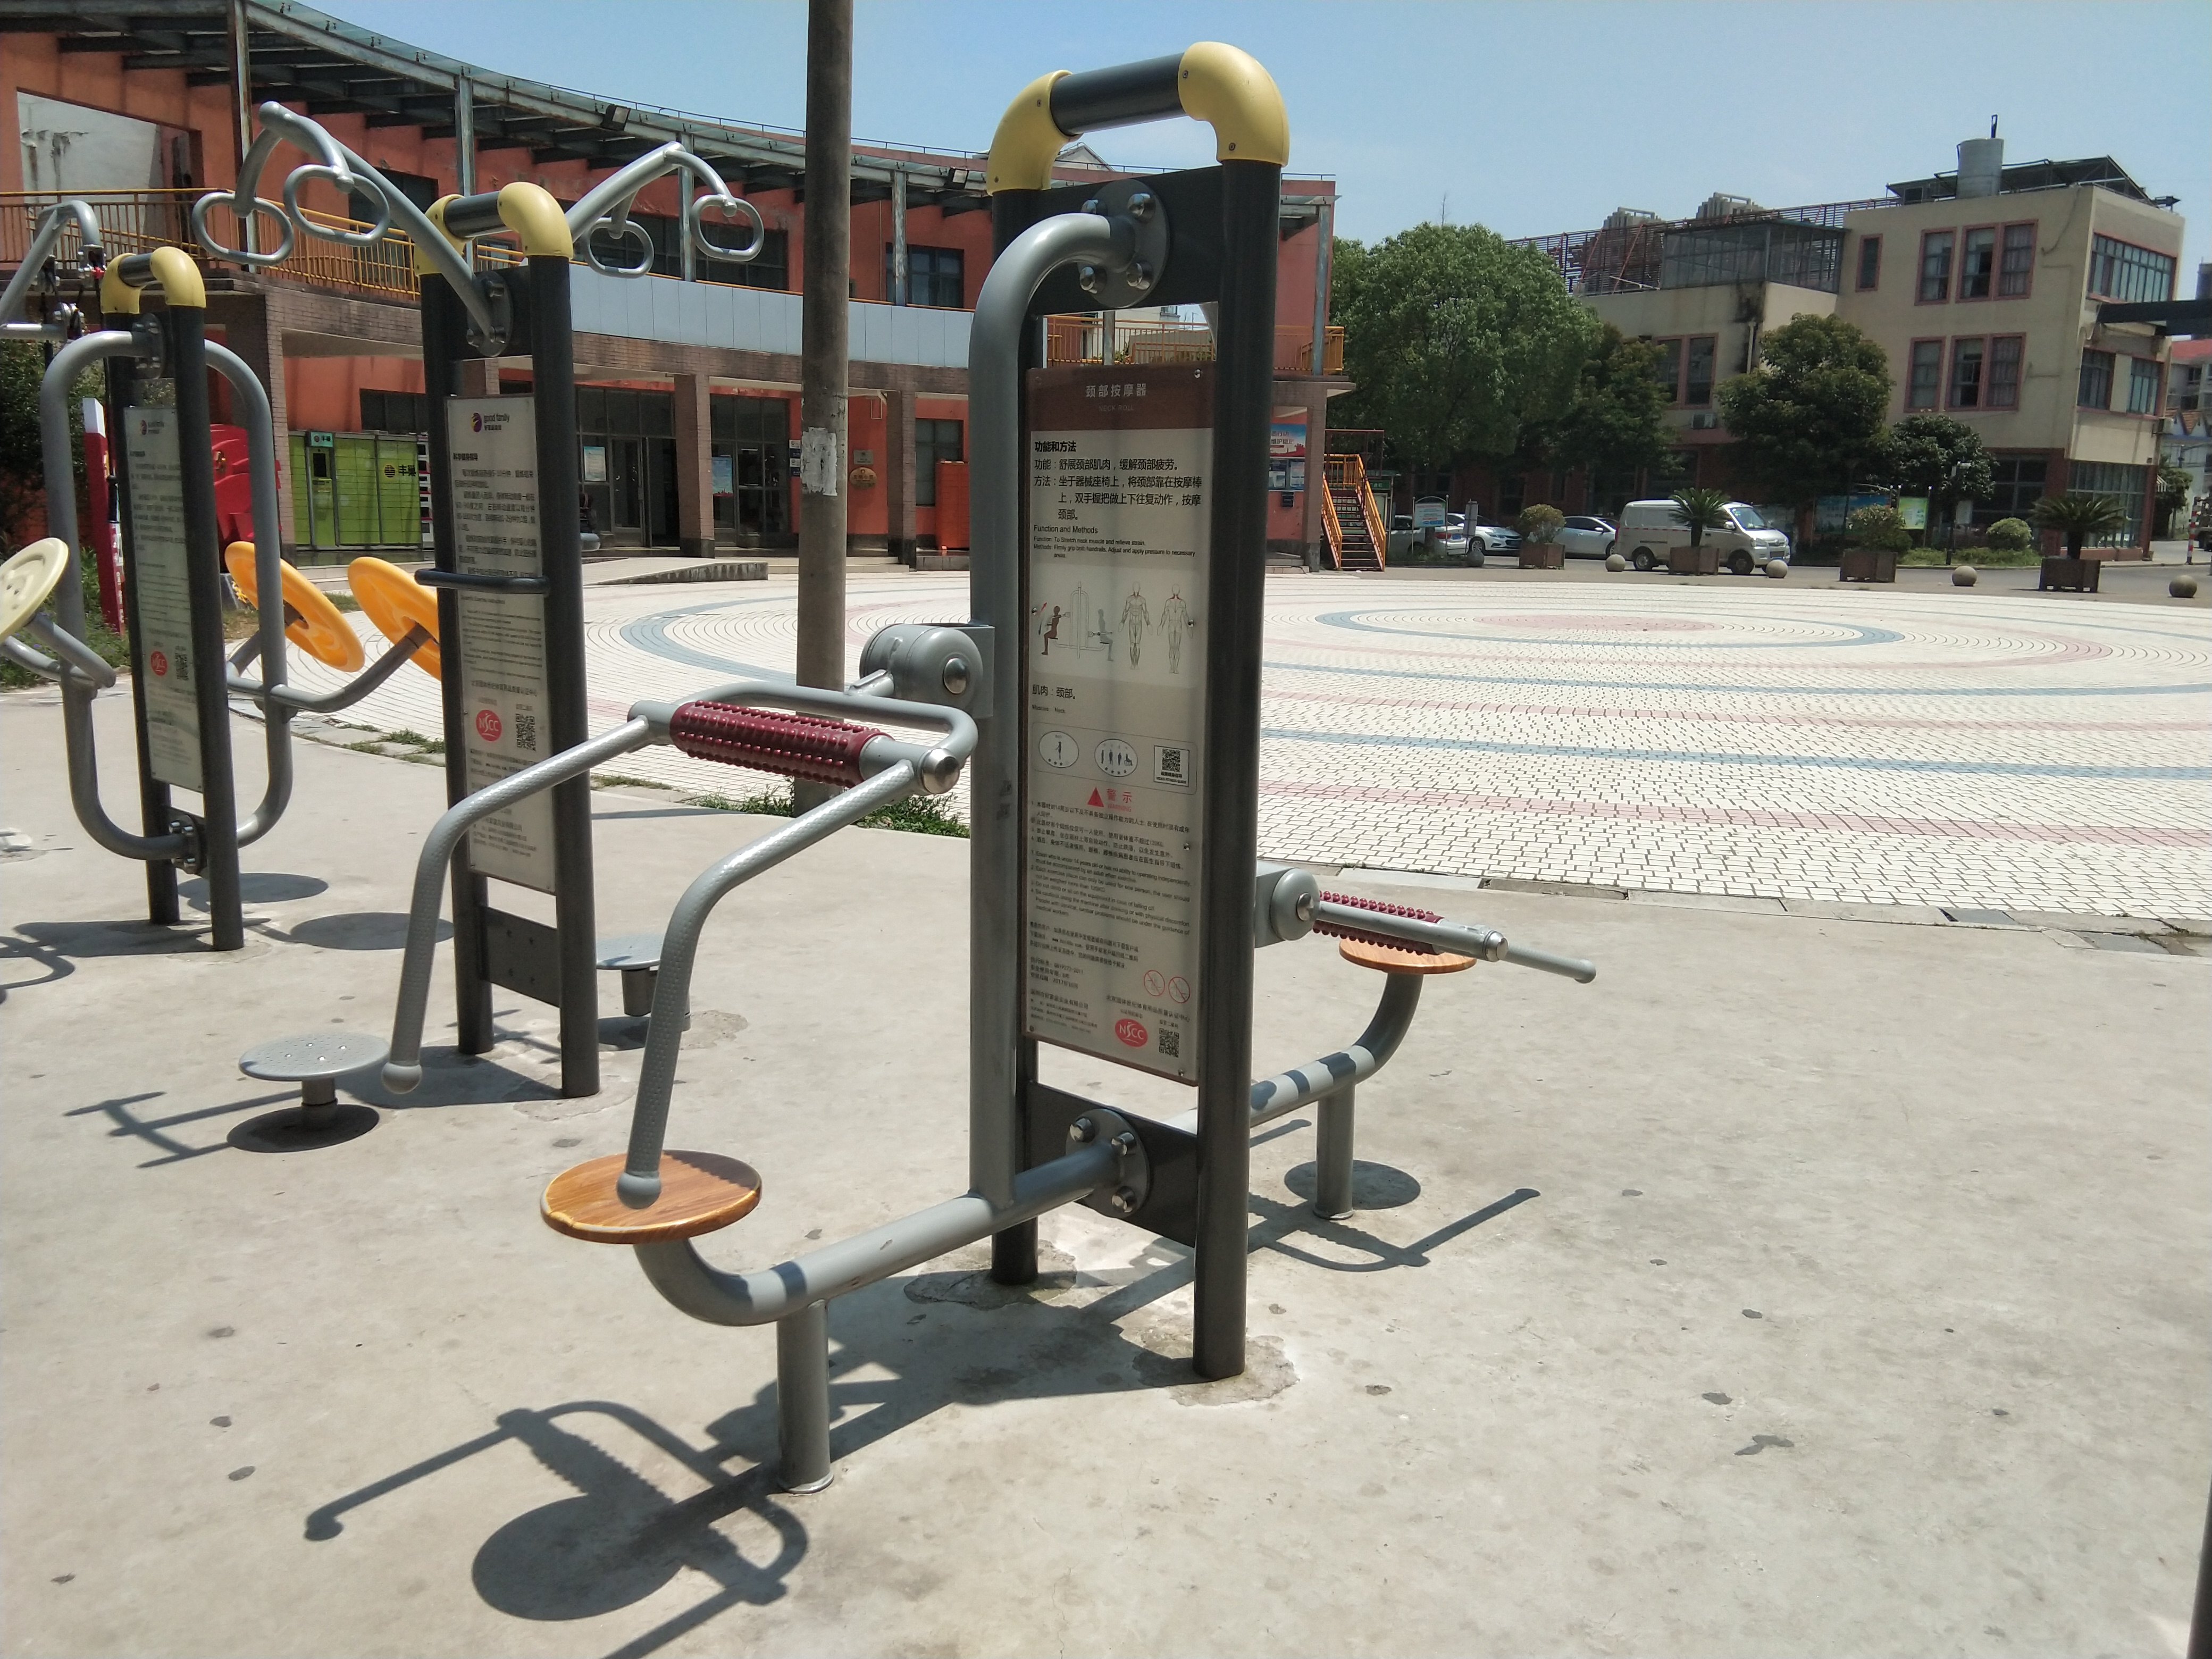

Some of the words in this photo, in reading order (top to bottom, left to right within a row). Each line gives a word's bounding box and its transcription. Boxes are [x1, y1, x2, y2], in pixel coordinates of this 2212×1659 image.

[1086, 383, 1146, 398] 颈部按摩器
[484, 414, 496, 423] good
[496, 413, 510, 423] family
[1035, 441, 1077, 453] 功能和方法
[399, 464, 416, 476] 丰巢
[1058, 509, 1078, 521] 颈部。
[479, 714, 499, 733] NSCC
[1107, 788, 1132, 803] 警示
[1119, 1021, 1144, 1040] NSCC
